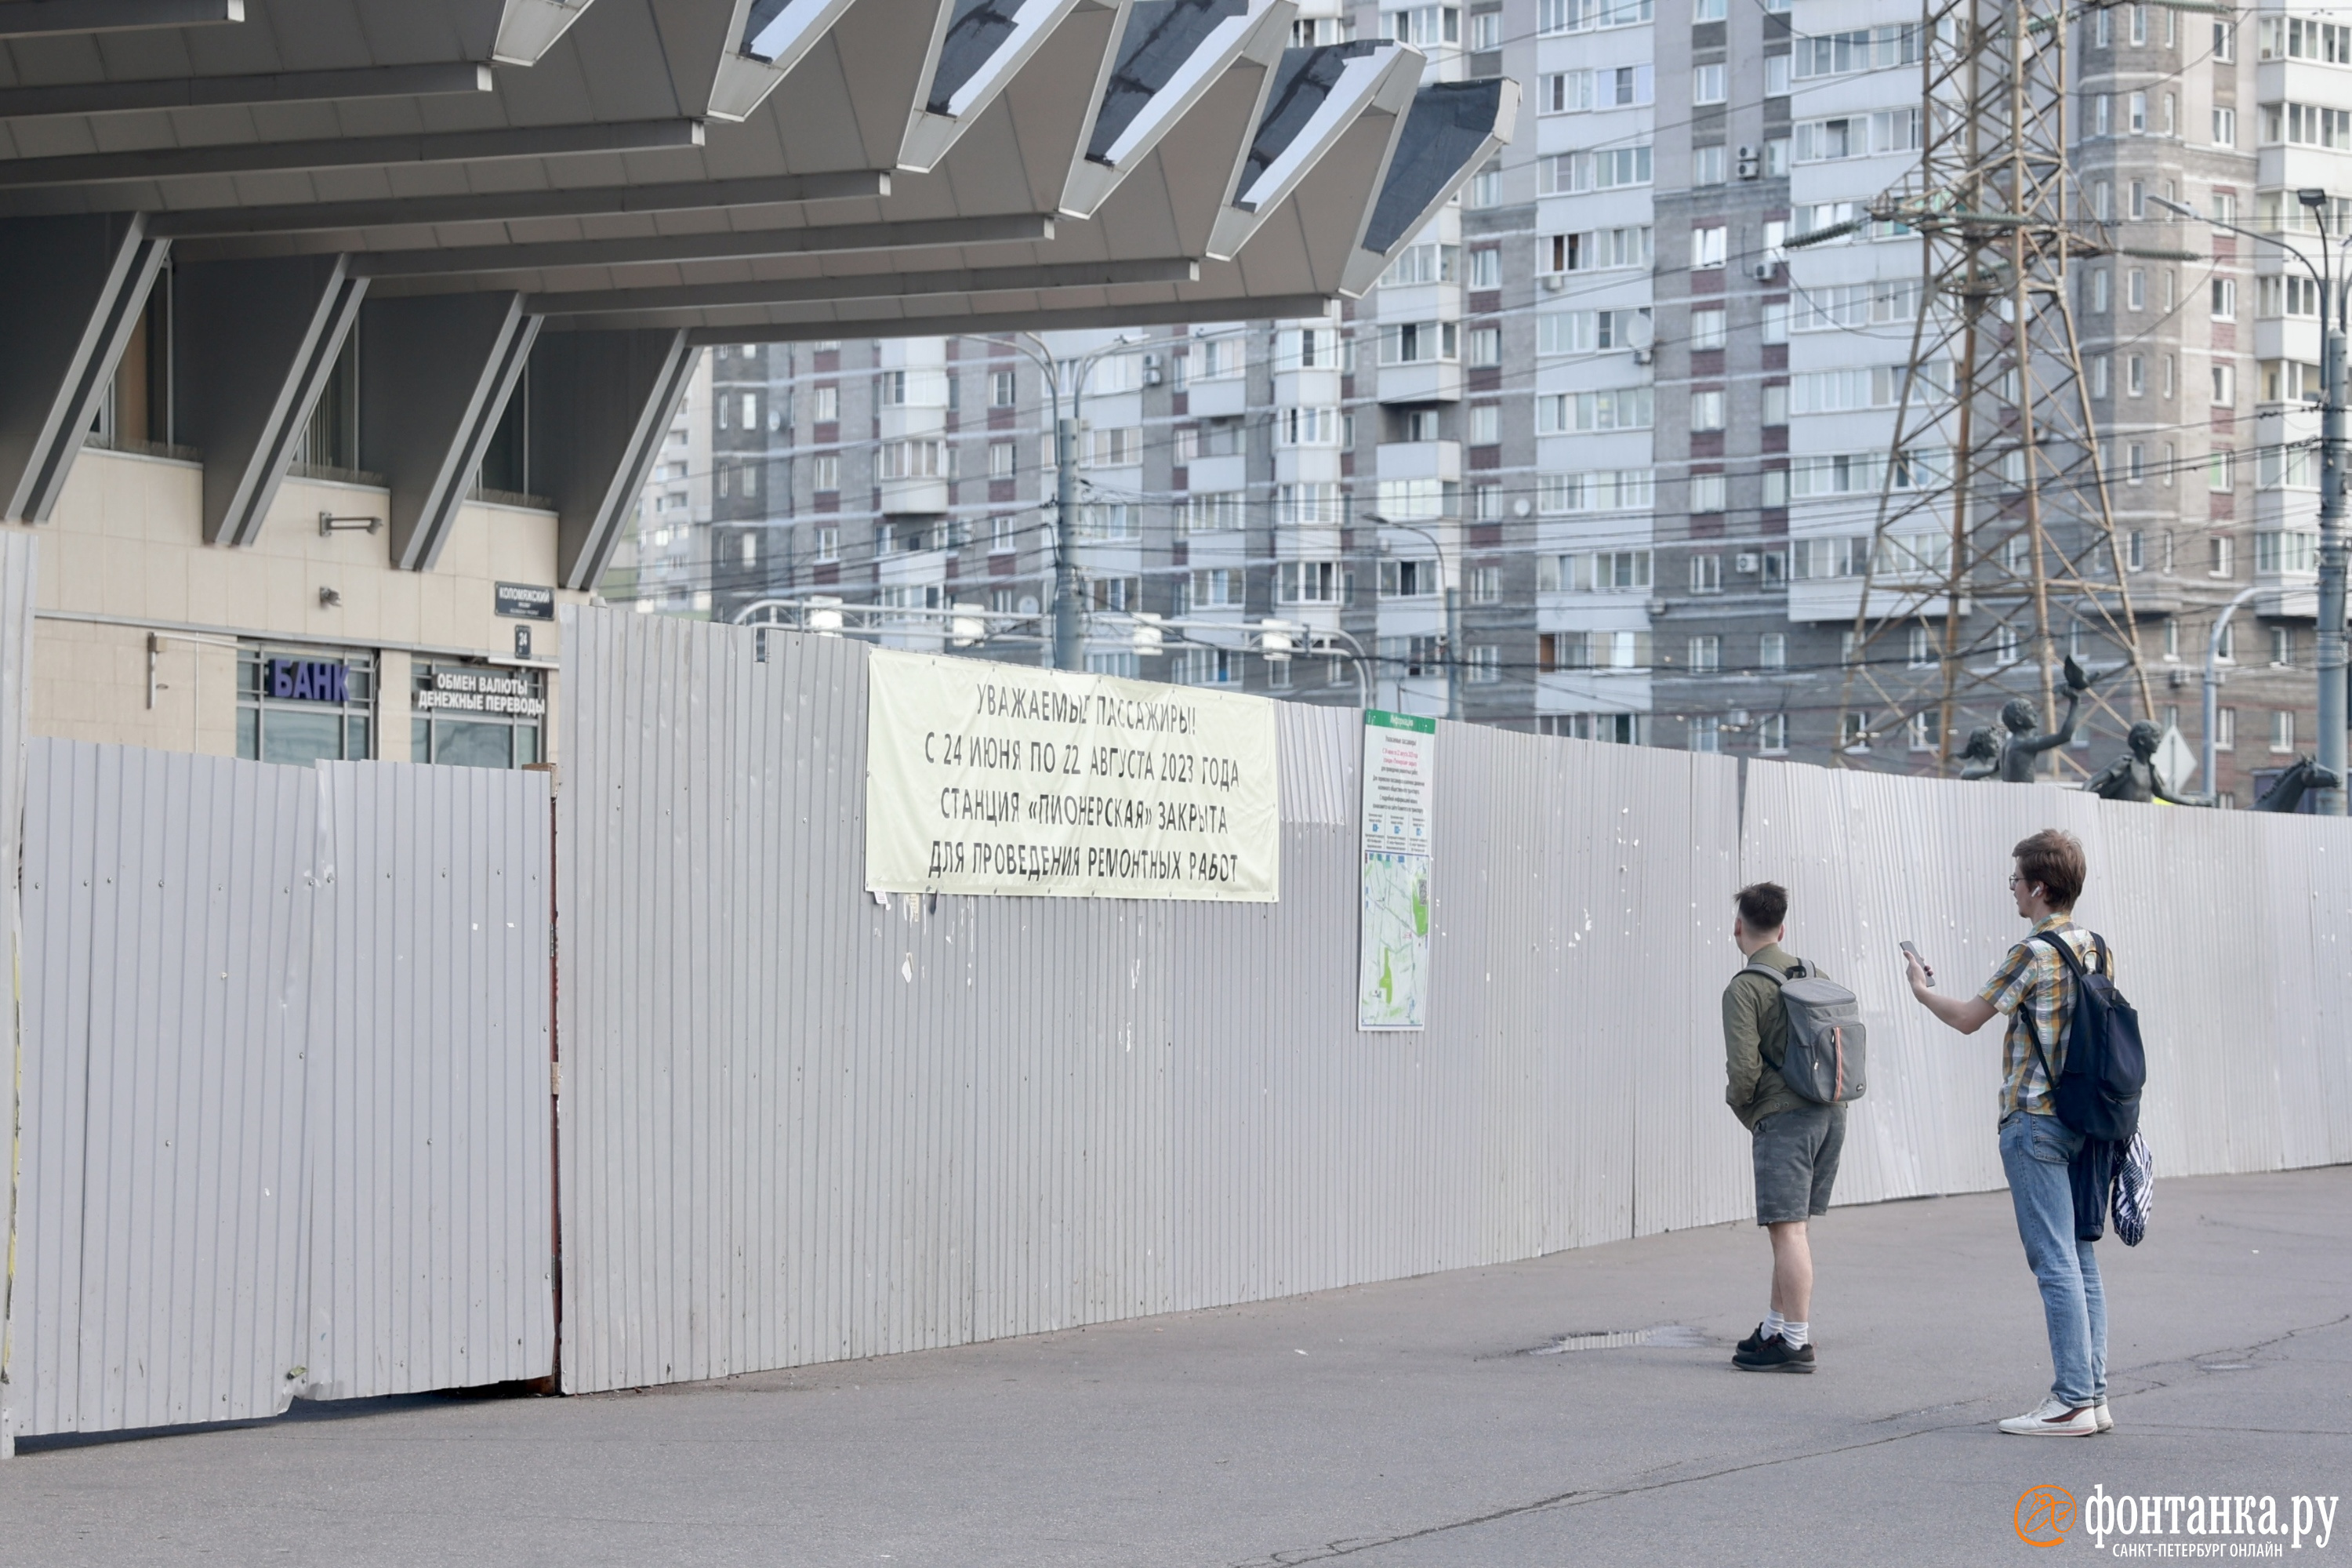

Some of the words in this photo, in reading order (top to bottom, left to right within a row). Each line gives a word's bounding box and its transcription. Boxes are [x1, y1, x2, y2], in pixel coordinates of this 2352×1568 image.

[499, 587, 550, 604] КОЛОМЯЖСКИЙ
[517, 632, 528, 647] 24
[271, 659, 350, 702] БАНК
[437, 673, 477, 691] ОБМЕН
[478, 677, 528, 695] ВАЛЮТЫ
[418, 690, 483, 711] ДЕНЕЖНЫЕ
[485, 695, 546, 715] ПЕРЕВОДЫ
[977, 684, 1091, 724] УВАЖАЕМЫЕ
[1097, 695, 1196, 735] ПАССАЖИРЫ!
[924, 731, 935, 764] С
[943, 733, 962, 766] 24
[970, 735, 1022, 771] ИЮНЯ
[1030, 742, 1056, 773] ПО
[1062, 744, 1081, 775] 22
[1090, 746, 1155, 781] АВГУСТА
[1161, 752, 1193, 782] 2023
[1202, 757, 1240, 793] ГОДА
[941, 786, 1020, 827] СТАНЦИЯ
[1028, 794, 1152, 829] «ПИОНЕРСКАЯ»
[1158, 801, 1229, 834] ЗАКРЫТА
[927, 840, 964, 879] ДЛЯ
[972, 842, 1080, 882] ПРОВЕДЕНИЯ
[1087, 847, 1181, 880] РЕМОНТНЫХ
[1189, 851, 1238, 883] РАБОТ
